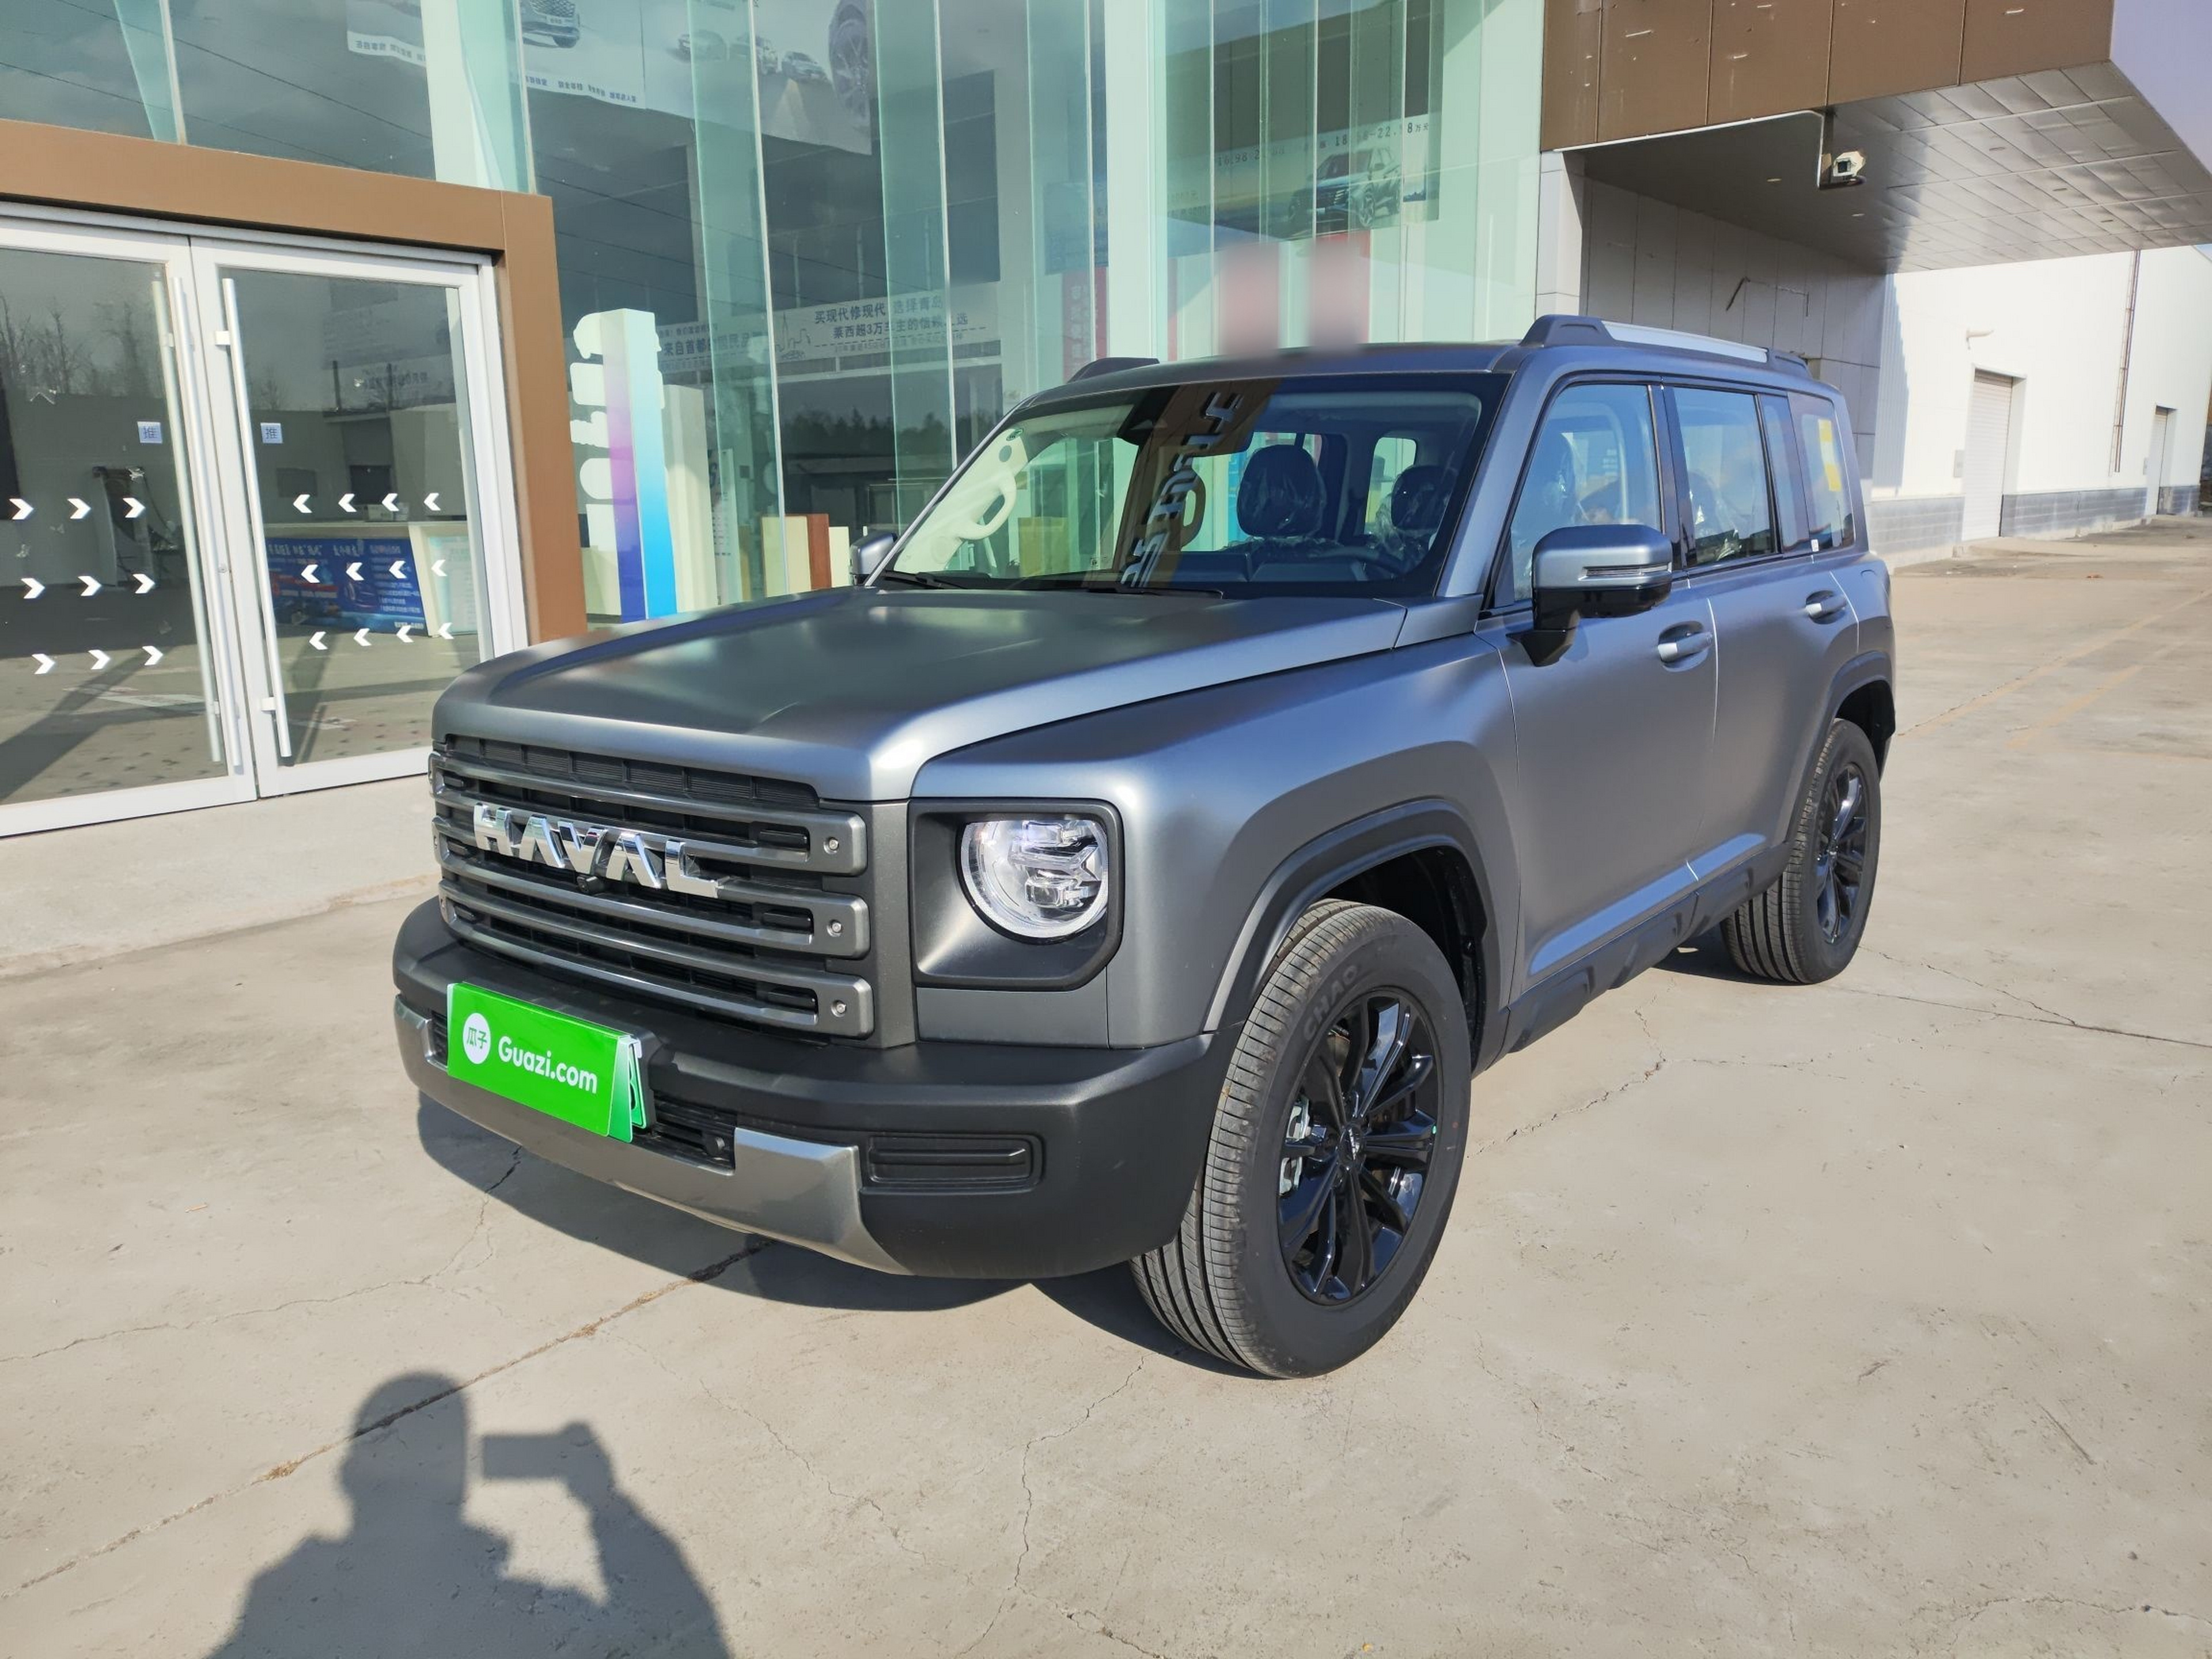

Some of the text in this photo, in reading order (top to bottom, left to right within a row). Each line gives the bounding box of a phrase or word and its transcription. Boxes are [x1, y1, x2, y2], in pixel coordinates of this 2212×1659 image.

[815, 302, 885, 324] 买现代修现代
[833, 312, 968, 339] 莱西超3万车主的信赖选
[664, 331, 768, 356] 来自首都国民品
[142, 426, 158, 439] 推
[265, 427, 277, 439] 推
[474, 802, 721, 899] HAVAL
[467, 1027, 599, 1094] 瓜子 Guazi.com
